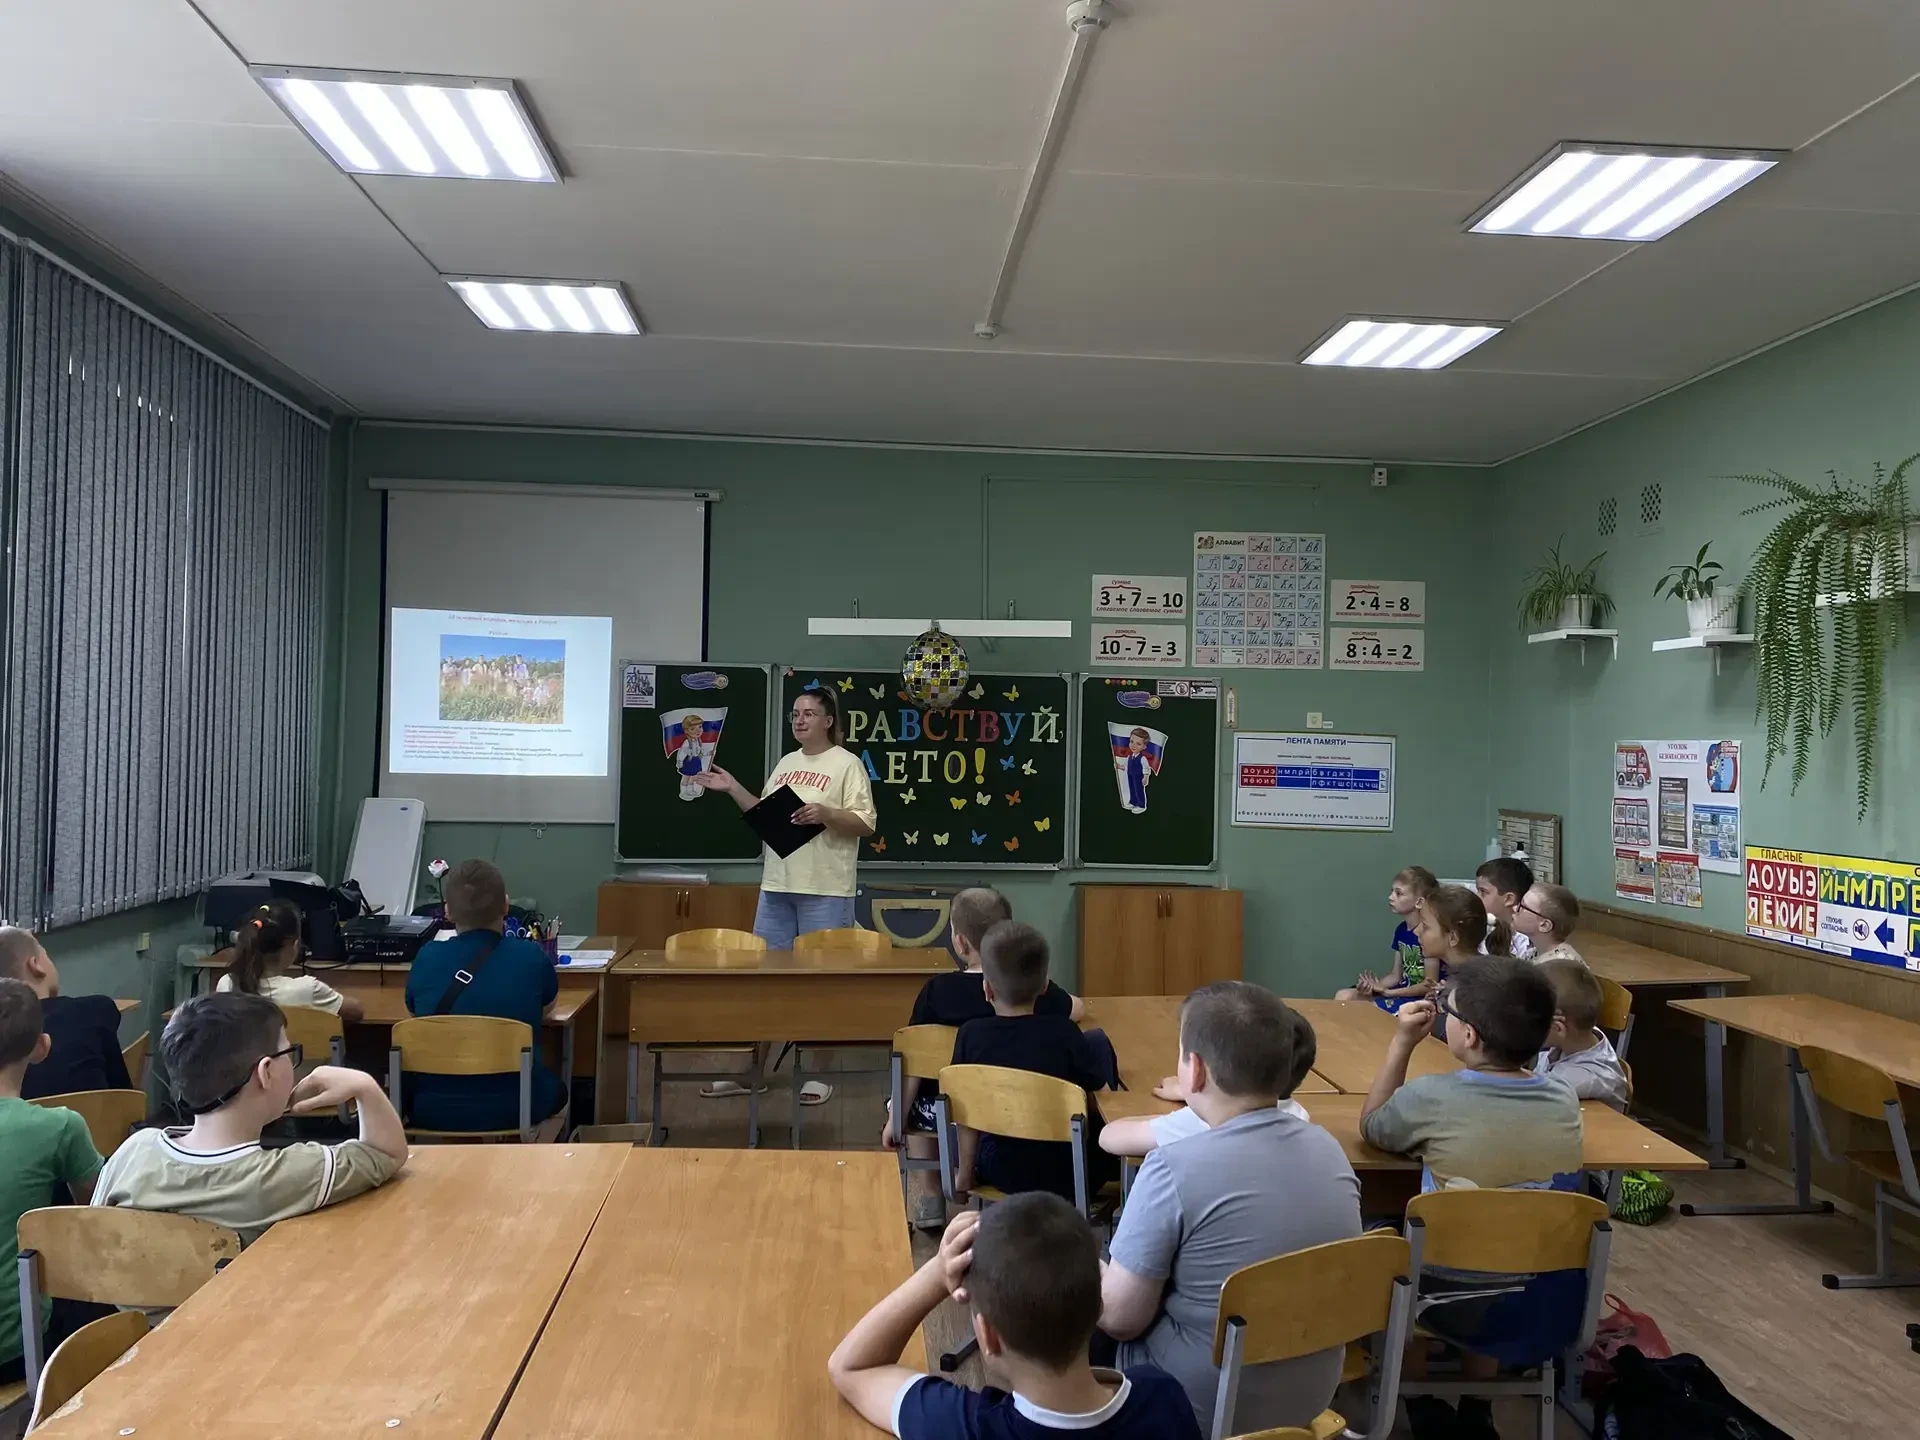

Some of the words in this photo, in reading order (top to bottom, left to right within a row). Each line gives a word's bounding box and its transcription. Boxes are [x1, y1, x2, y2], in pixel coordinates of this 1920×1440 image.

[1252, 541, 1269, 551] Аа
[1279, 542, 1292, 551] Бб
[1305, 542, 1318, 551] Вв
[1300, 561, 1321, 571] Жж
[1100, 591, 1110, 605] 3
[1116, 594, 1126, 605] +
[1132, 592, 1141, 606] 7
[1163, 593, 1183, 608] 10
[1198, 597, 1217, 607] Мм
[1255, 597, 1268, 607] Оо
[1346, 596, 1356, 610] 2
[1370, 597, 1380, 610] 4
[1400, 597, 1409, 611] 8
[1100, 640, 1120, 654] 10
[1136, 641, 1146, 655] 7
[1167, 642, 1176, 656] 3
[1346, 643, 1356, 658] 8
[1371, 644, 1382, 658] 4
[1402, 645, 1412, 659] 2
[1313, 738, 1347, 746] ПАМЯТИ
[1761, 848, 1803, 863] ГЛАСНЫЕ
[1825, 916, 1842, 926] ГЛУХИЕ
[1820, 922, 1848, 934] СОГЛАСНЫЕ
